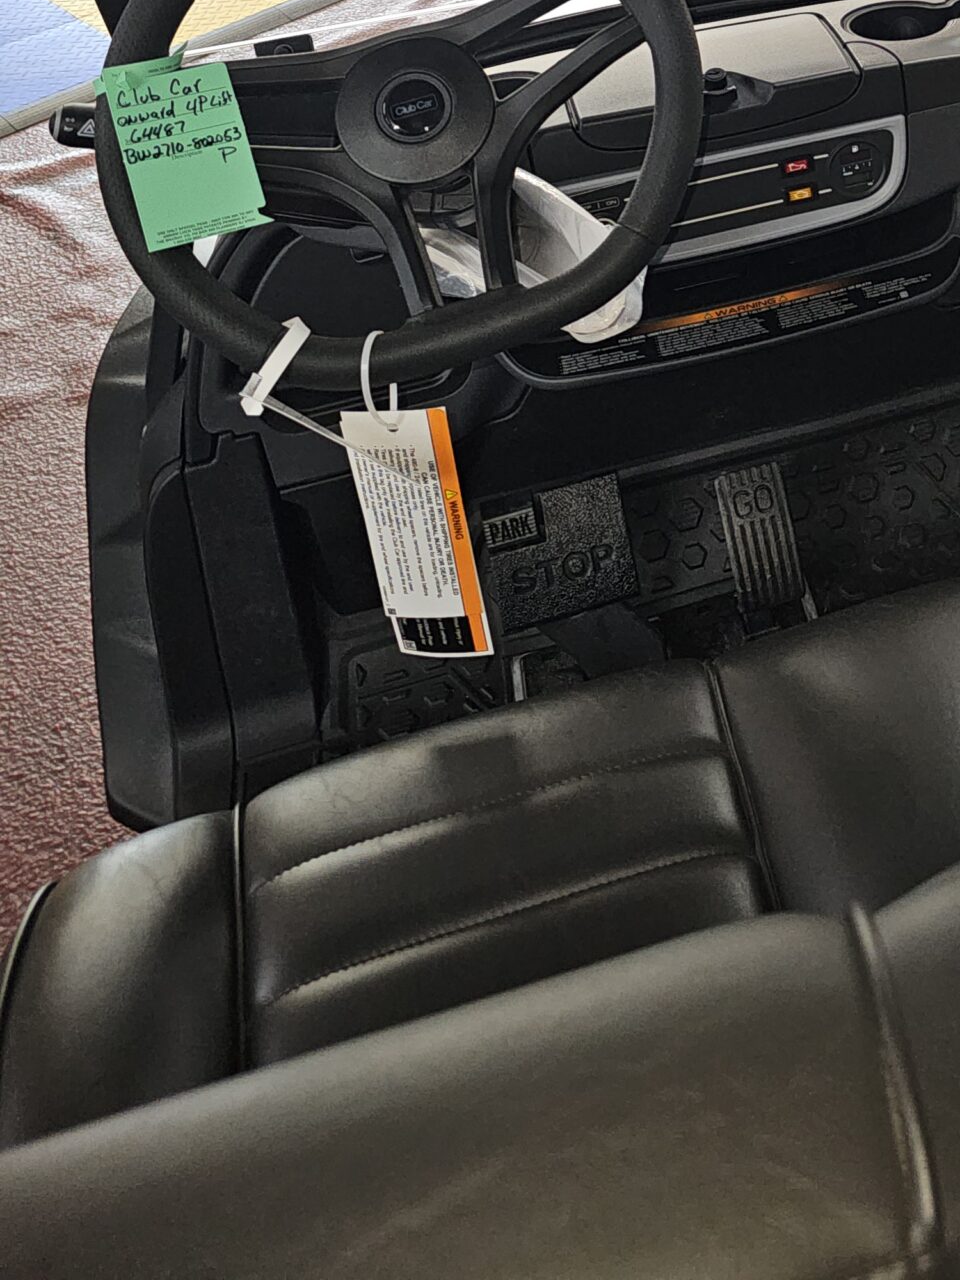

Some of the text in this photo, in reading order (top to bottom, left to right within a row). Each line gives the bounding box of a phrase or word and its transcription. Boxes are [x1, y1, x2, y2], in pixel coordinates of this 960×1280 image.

[117, 78, 203, 108] Club Car
[395, 100, 433, 117] Club Car
[714, 298, 776, 316] WARNING
[427, 460, 435, 472] USE
[420, 472, 429, 484] CAN
[429, 473, 437, 481] OF
[423, 485, 433, 503] CAUSE
[431, 482, 442, 506] VEHICLE
[732, 484, 774, 518] GO
[427, 506, 439, 536] PERSONAL
[436, 508, 445, 521] WITH
[448, 500, 465, 540] WARNING
[439, 523, 450, 547] SHIPPING
[488, 514, 533, 543] PARK
[434, 537, 443, 555] INJURY
[445, 550, 453, 565] TIRES
[511, 544, 613, 595] STOP
